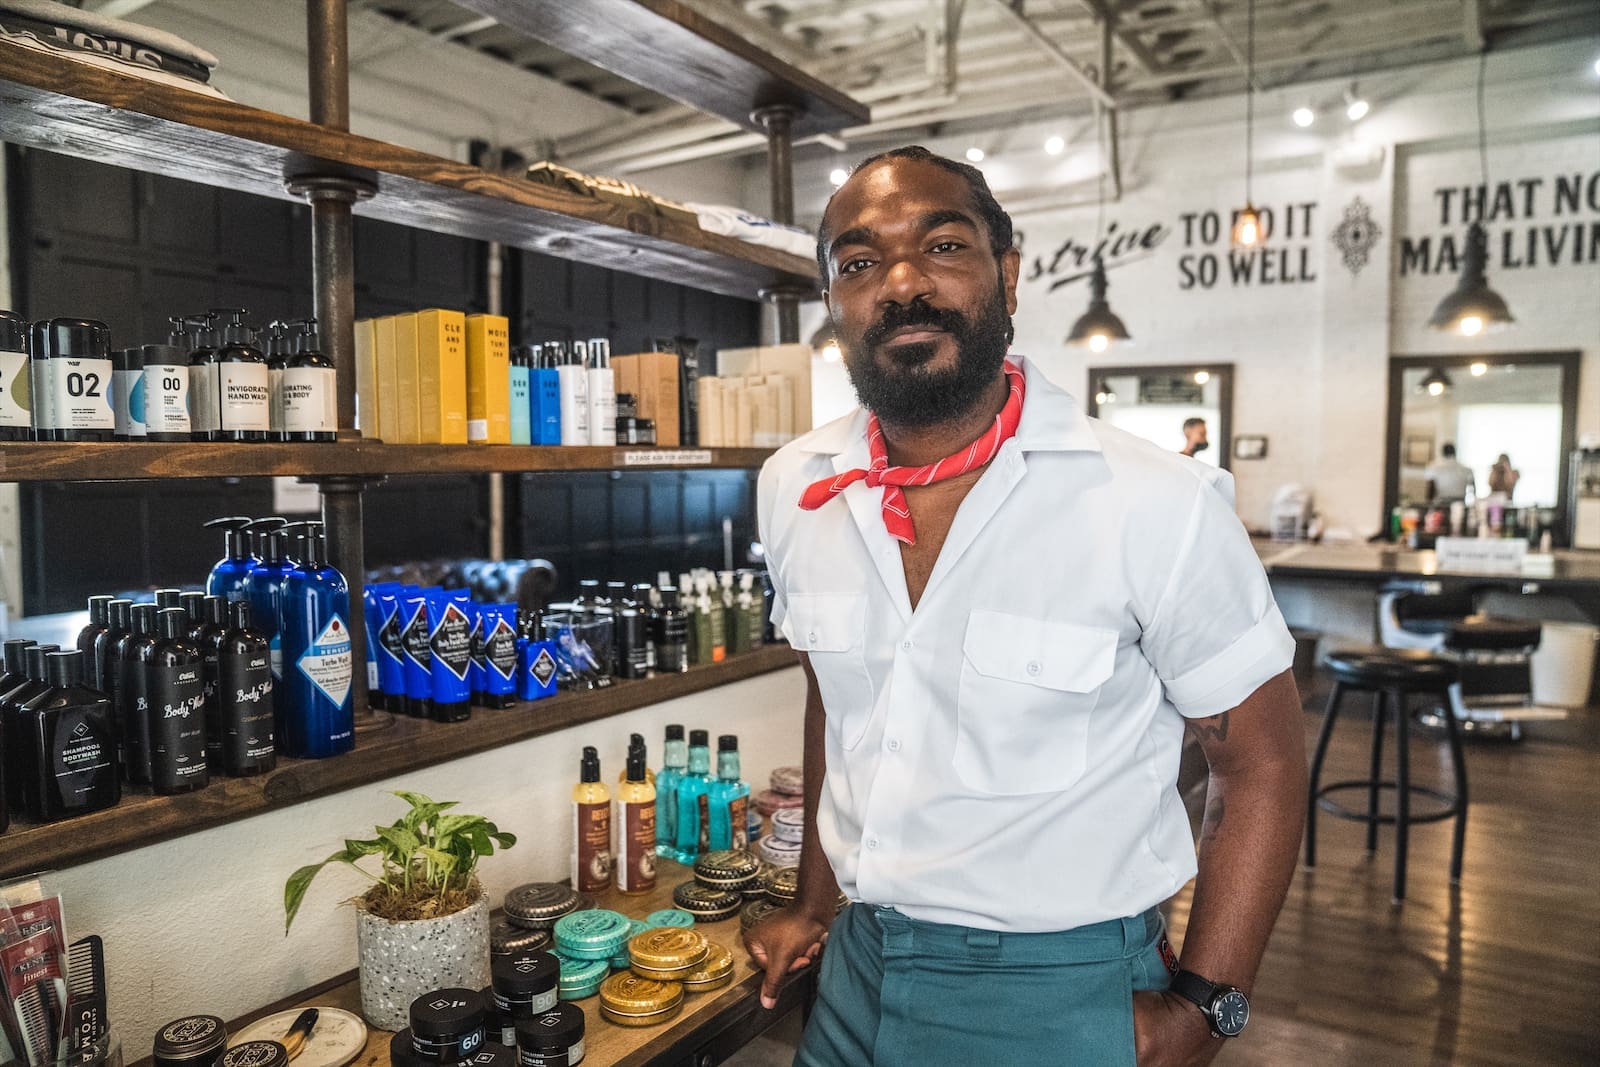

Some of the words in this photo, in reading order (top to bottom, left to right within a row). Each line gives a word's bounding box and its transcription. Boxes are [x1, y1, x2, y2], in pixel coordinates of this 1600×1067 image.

[1434, 179, 1544, 225] THAT
[1179, 210, 1221, 247] TO
[1285, 202, 1318, 238] IT
[1026, 211, 1171, 282] strive
[1400, 232, 1486, 277] MA
[1178, 253, 1219, 290] SO
[1228, 246, 1317, 287] WELL
[488, 329, 507, 337] MOIS
[66, 372, 101, 398] 02
[163, 377, 180, 391] 00
[228, 393, 250, 401] HAND
[250, 393, 267, 401] WASH
[292, 391, 311, 400] BODY
[236, 686, 261, 703] Body
[163, 701, 191, 718] Body
[62, 749, 101, 763] BODYWASH
[19, 956, 45, 973] KENT
[23, 967, 49, 986] finest
[537, 993, 554, 1009] 90
[81, 1010, 94, 1063] COMB
[462, 1032, 480, 1050] 60
